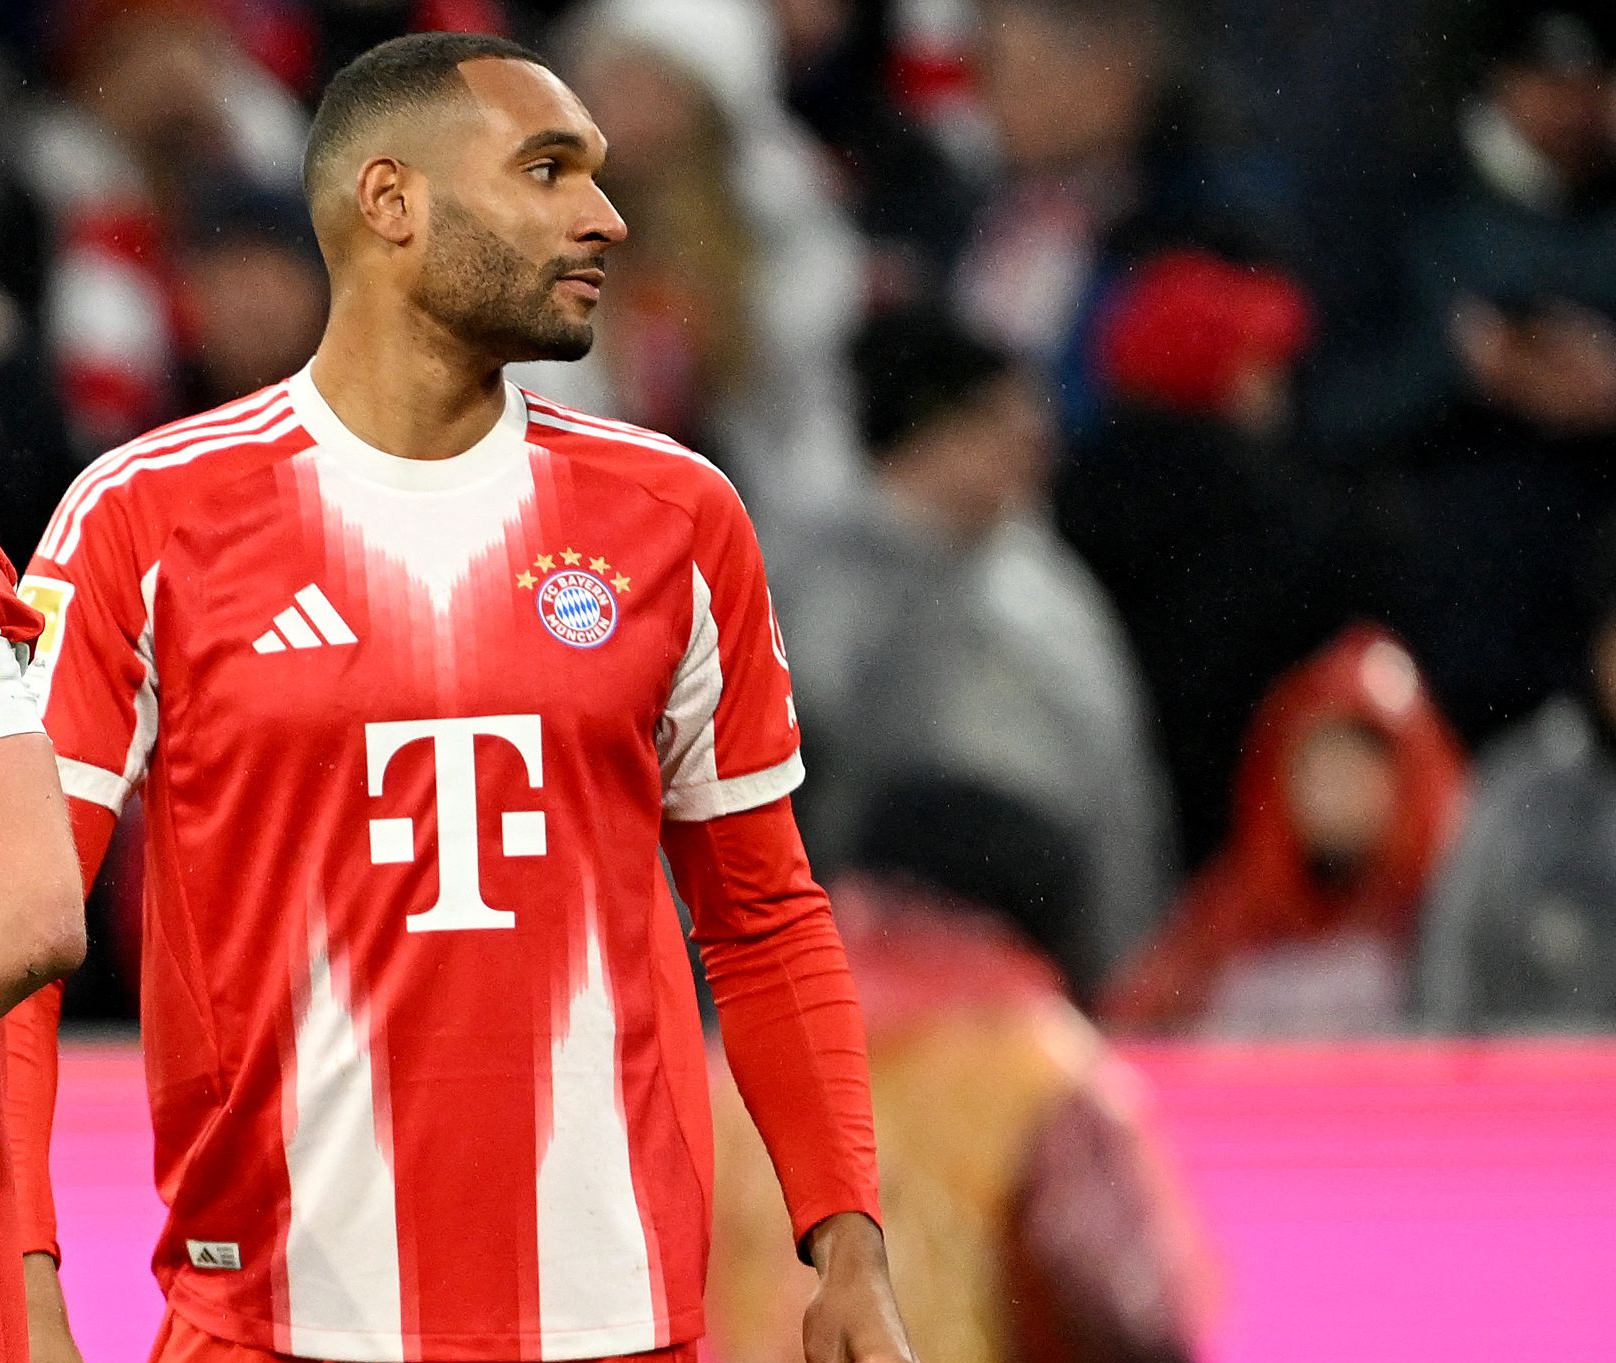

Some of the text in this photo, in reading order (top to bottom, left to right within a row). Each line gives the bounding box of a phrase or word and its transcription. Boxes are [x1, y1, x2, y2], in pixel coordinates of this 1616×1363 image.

[543, 575, 610, 606] FC BAYERN
[365, 714, 547, 933] T
